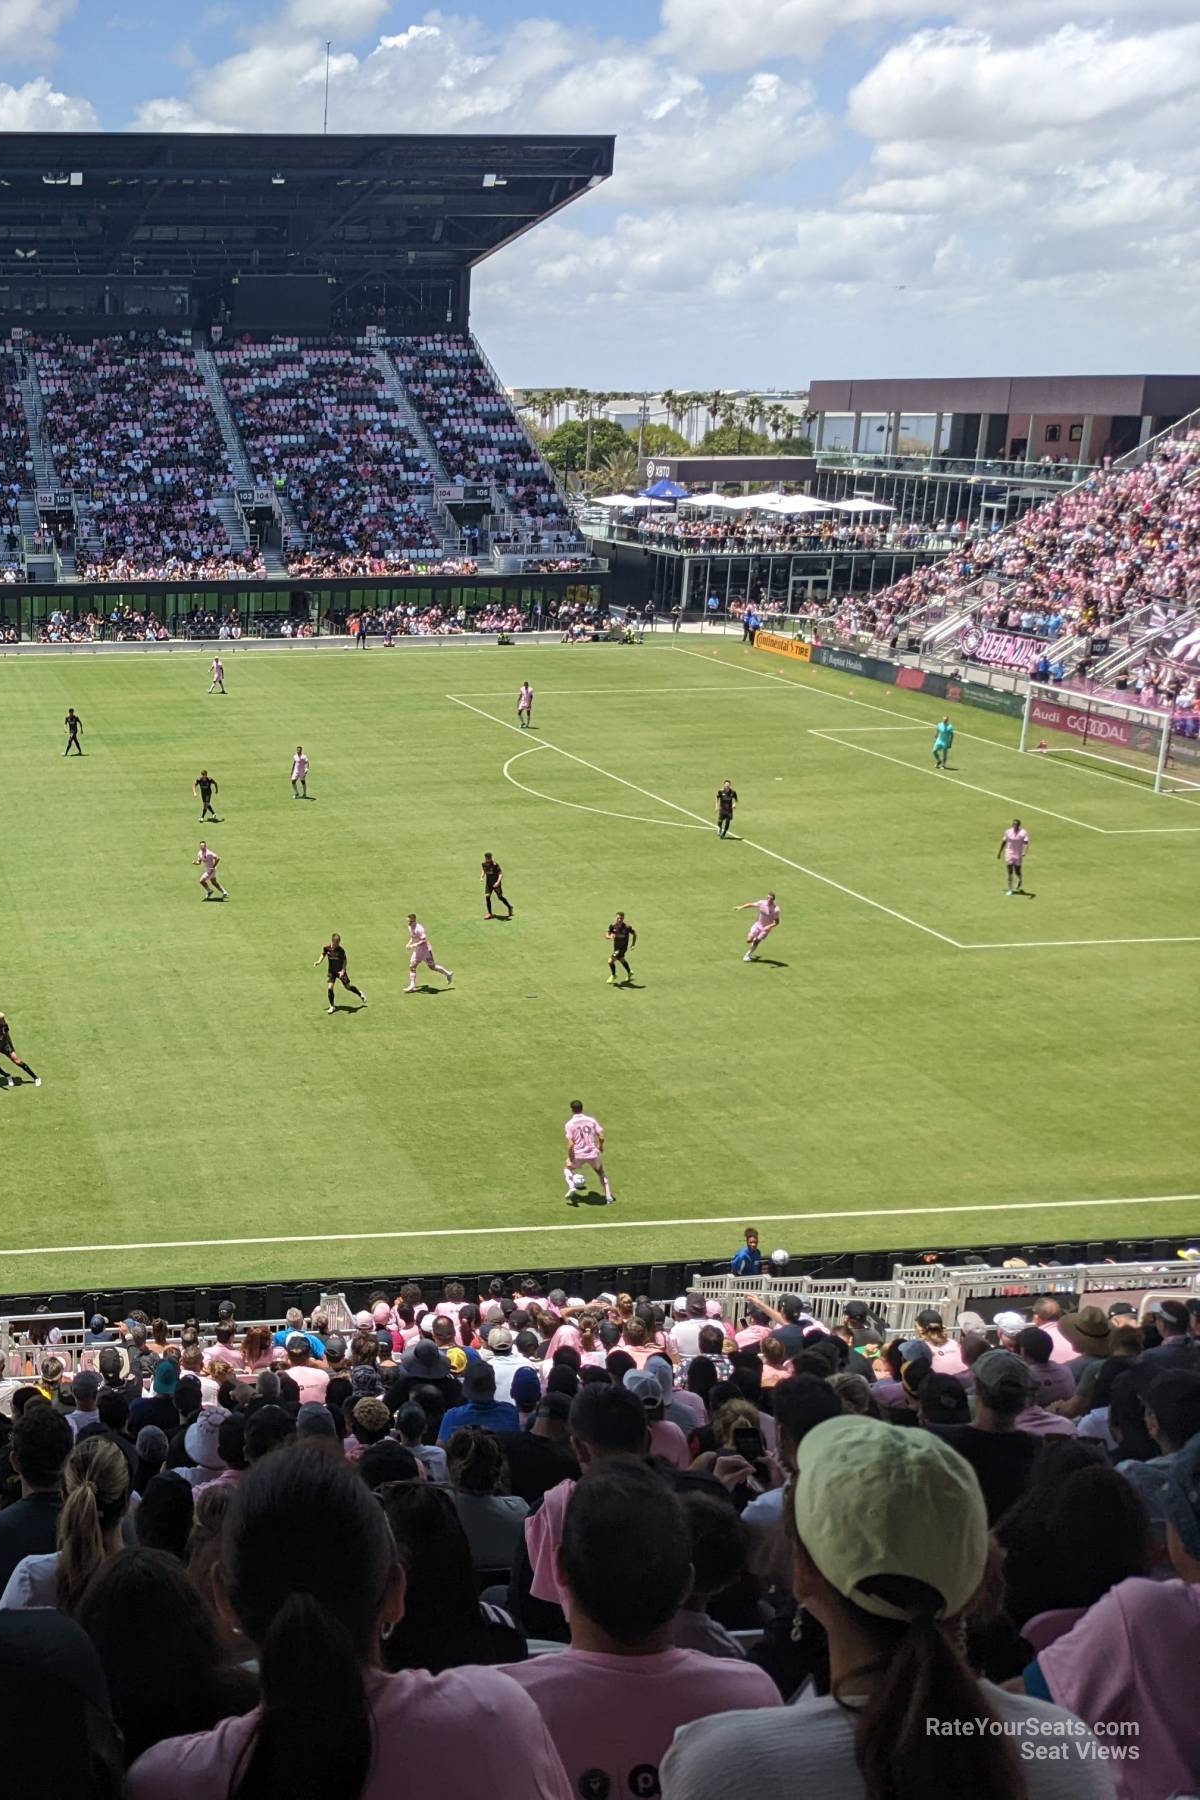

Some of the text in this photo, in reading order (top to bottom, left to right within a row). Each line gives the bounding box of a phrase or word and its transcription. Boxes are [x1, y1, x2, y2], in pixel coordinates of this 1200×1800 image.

[655, 465, 670, 478] XBTO
[756, 631, 809, 658] Continental TIRE
[1092, 643, 1106, 652] 107
[1032, 707, 1060, 722] Audi
